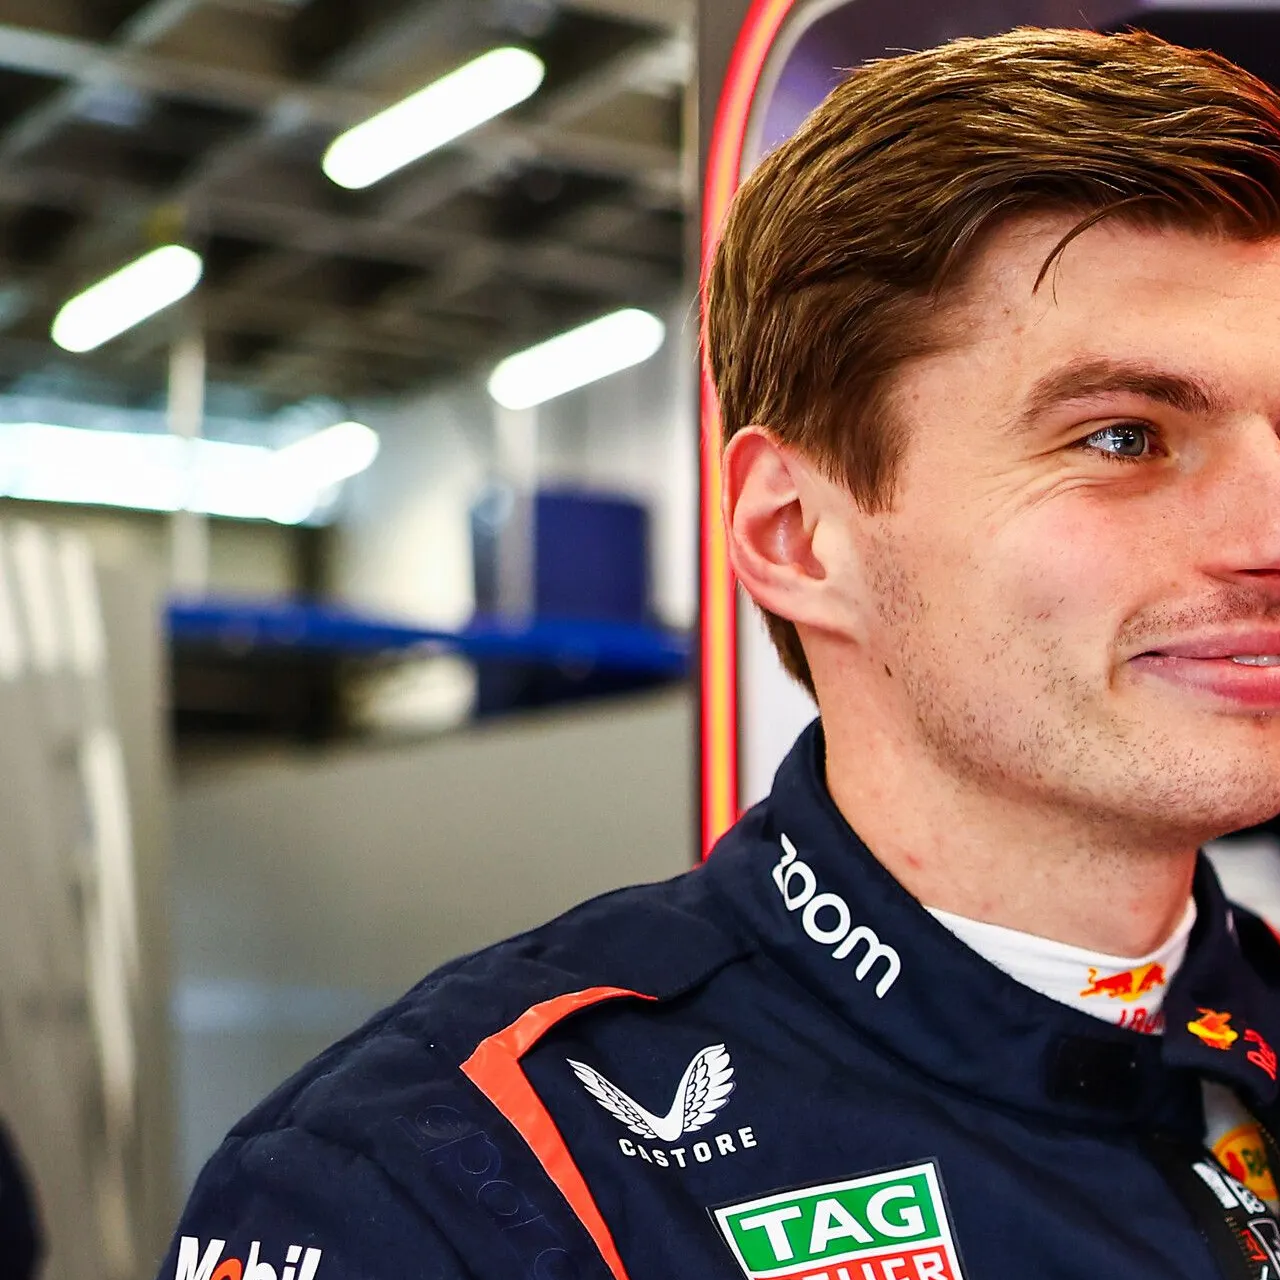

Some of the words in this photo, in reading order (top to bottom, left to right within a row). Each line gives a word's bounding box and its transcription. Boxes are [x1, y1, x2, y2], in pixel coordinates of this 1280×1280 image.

[771, 832, 901, 999] zoom
[618, 1126, 758, 1169] CASTORE
[738, 1183, 927, 1262] TAG
